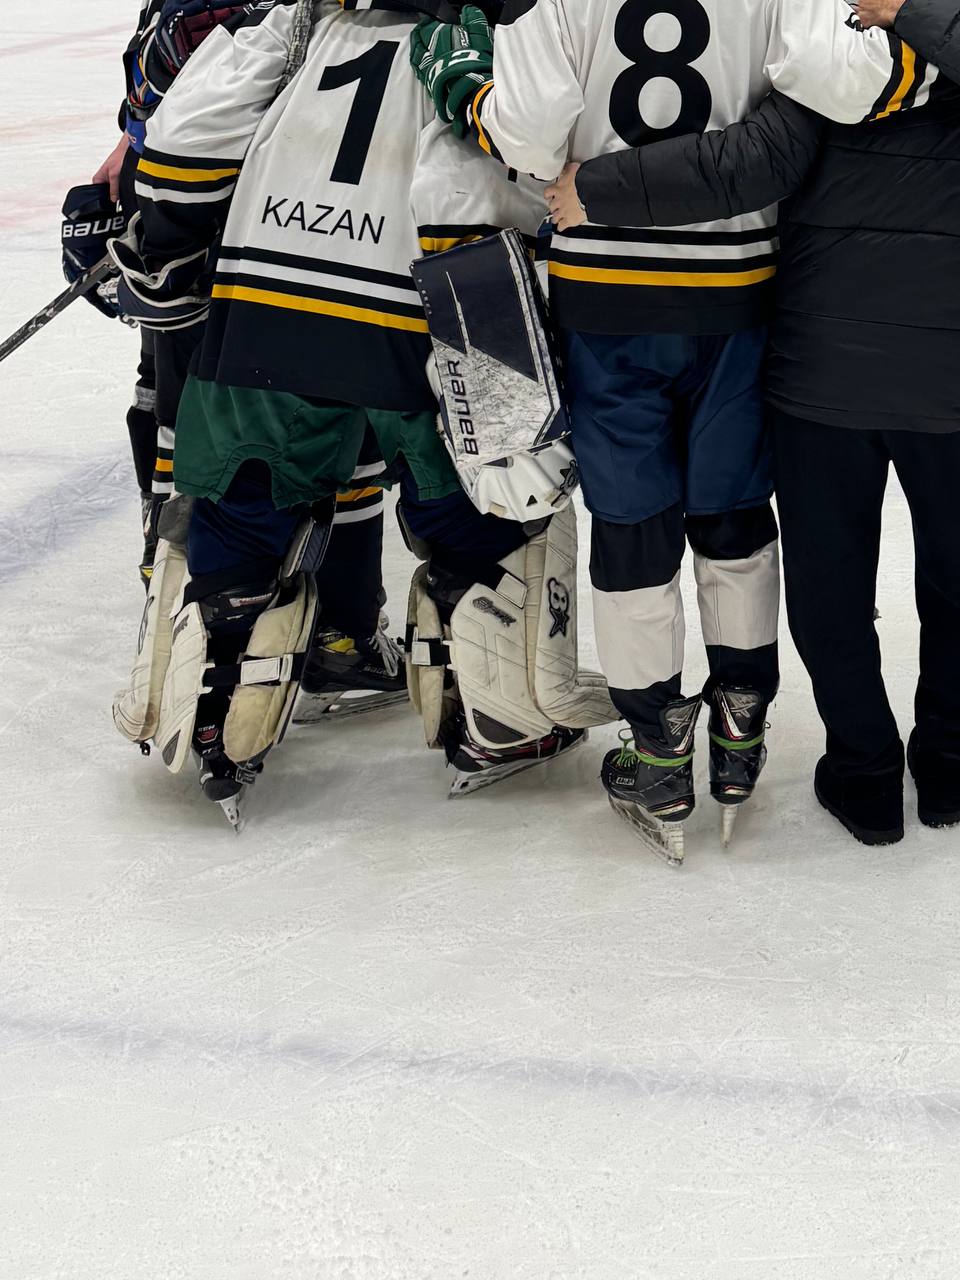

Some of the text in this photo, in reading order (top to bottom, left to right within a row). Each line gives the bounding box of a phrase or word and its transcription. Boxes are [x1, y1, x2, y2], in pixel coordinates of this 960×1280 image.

[317, 39, 400, 186] 1
[62, 215, 125, 239] BAUE
[260, 195, 386, 245] KAZAN
